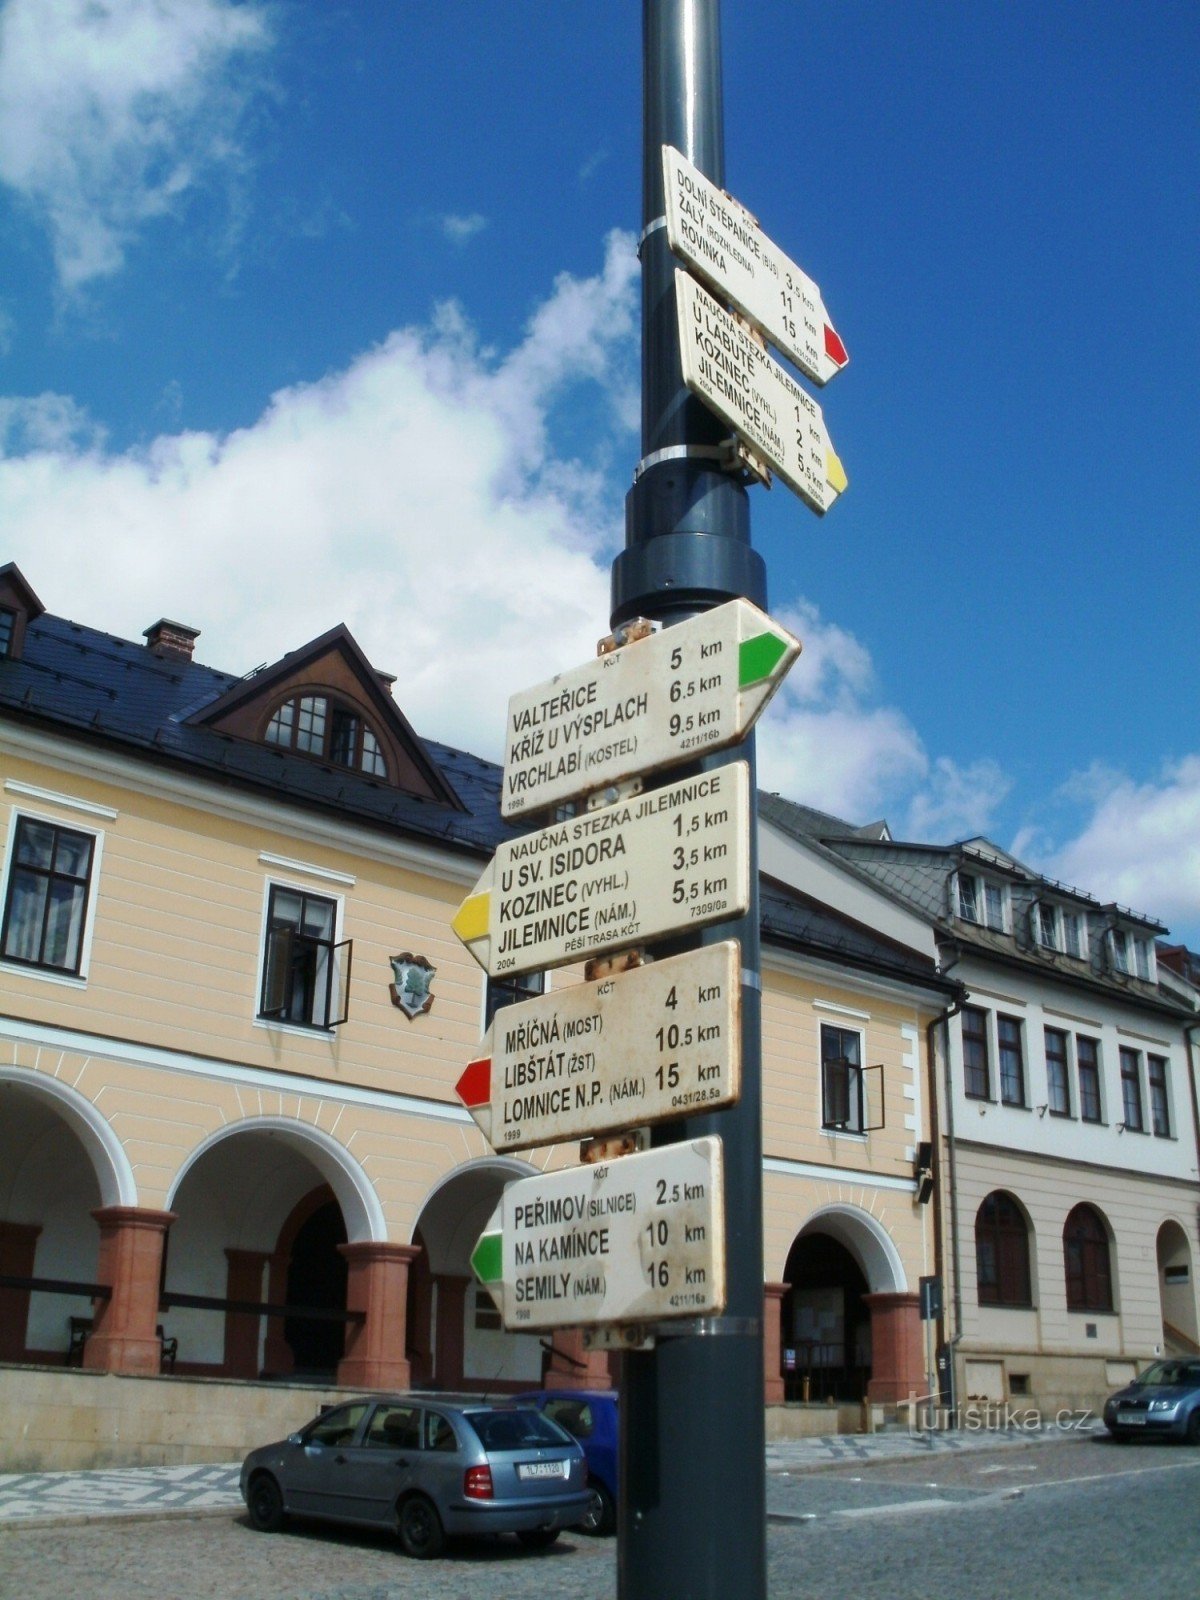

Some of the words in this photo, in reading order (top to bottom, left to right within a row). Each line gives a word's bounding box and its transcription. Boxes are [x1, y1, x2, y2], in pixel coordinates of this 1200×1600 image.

[678, 168, 708, 209] DOLNÍ
[709, 196, 760, 259] ŠTĚPANICE
[762, 253, 779, 279] (BUS)
[801, 293, 815, 312] km
[679, 191, 704, 228] ŽALÝ
[707, 223, 755, 278] (ROZHLEDNA)
[780, 291, 793, 313] 11
[804, 316, 817, 337] km
[681, 218, 727, 274] ROVINKA
[782, 315, 796, 339] 15
[806, 340, 819, 360] km
[692, 302, 702, 323] U
[706, 315, 755, 376] LABUTĚ
[794, 405, 800, 422] 1
[809, 424, 821, 444] km
[696, 288, 736, 335] NAUČNÁ
[738, 330, 773, 374] STEZKA
[773, 367, 816, 418] JILEMNICE
[695, 328, 750, 394] KOZINEC
[752, 387, 777, 424] (VYHL.)
[796, 429, 803, 449] 2
[811, 448, 823, 468] km
[699, 357, 761, 430] JILEMNICE
[762, 422, 785, 456] (NÁM.)
[812, 472, 824, 493] km
[510, 729, 544, 765] KŘÍŽ
[548, 731, 558, 750] U
[563, 692, 648, 746] VÝSPLACH
[670, 680, 695, 703] 6.5
[699, 674, 722, 694] km
[513, 681, 597, 733] VALTEŘICE
[670, 647, 682, 670] 5
[701, 639, 723, 660] km
[508, 751, 582, 795] VRCHLABÍ
[585, 735, 639, 772] (KOSTEL)
[669, 714, 694, 737] 9.5
[698, 708, 721, 728] km
[680, 729, 720, 750] 4211/16b
[501, 871, 513, 892] U
[519, 861, 544, 887] SV.
[549, 833, 626, 878] ISIDORA
[672, 813, 700, 838] 1,5
[704, 808, 728, 828] km
[510, 826, 570, 862] NAUČNÁ
[573, 808, 632, 840] STEZKA
[636, 776, 721, 820] JILEMNICE
[498, 907, 590, 954] JILEMNICE
[594, 900, 637, 931] (NÁM.)
[672, 879, 699, 904] 5,5
[703, 877, 728, 896] km
[500, 879, 578, 924] KOZINEC
[581, 870, 629, 902] (VYHL.)
[672, 846, 699, 871] 3,5
[704, 842, 728, 861] km
[690, 900, 728, 918] 7309/0a
[497, 958, 516, 971] 2004
[564, 936, 586, 952] PĚŠÍ
[587, 930, 619, 946] TRASA
[621, 922, 640, 937] KČT
[506, 1013, 560, 1054] MŘÍČNÁ
[563, 1014, 603, 1044] (MOST)
[665, 985, 678, 1011] 4
[698, 983, 721, 1003] km
[597, 982, 615, 996] KČT
[504, 1087, 571, 1124] LOMNICE
[576, 1080, 604, 1109] N.P.
[609, 1077, 646, 1106] (NÁM.)
[655, 1063, 680, 1091] 15
[697, 1063, 721, 1082] km
[505, 1050, 565, 1089] LIBŠTÁT
[567, 1052, 596, 1078] (ŽST)
[655, 1024, 693, 1052] 10.5
[697, 1023, 721, 1043] km
[504, 1130, 521, 1141] 1999
[593, 1166, 610, 1180] KČT
[515, 1194, 586, 1230] PEŘIMOV
[587, 1192, 636, 1221] (SILNICE)
[656, 1179, 680, 1206] 2.5
[684, 1182, 705, 1201] km
[515, 1241, 534, 1266] NA
[539, 1228, 609, 1262] KAMÍNCE
[646, 1220, 668, 1248] 10
[685, 1225, 705, 1243] km
[515, 1273, 571, 1302] SEMILY
[573, 1274, 607, 1300] (NÁM.)
[647, 1260, 669, 1289] 16
[685, 1266, 706, 1284] km
